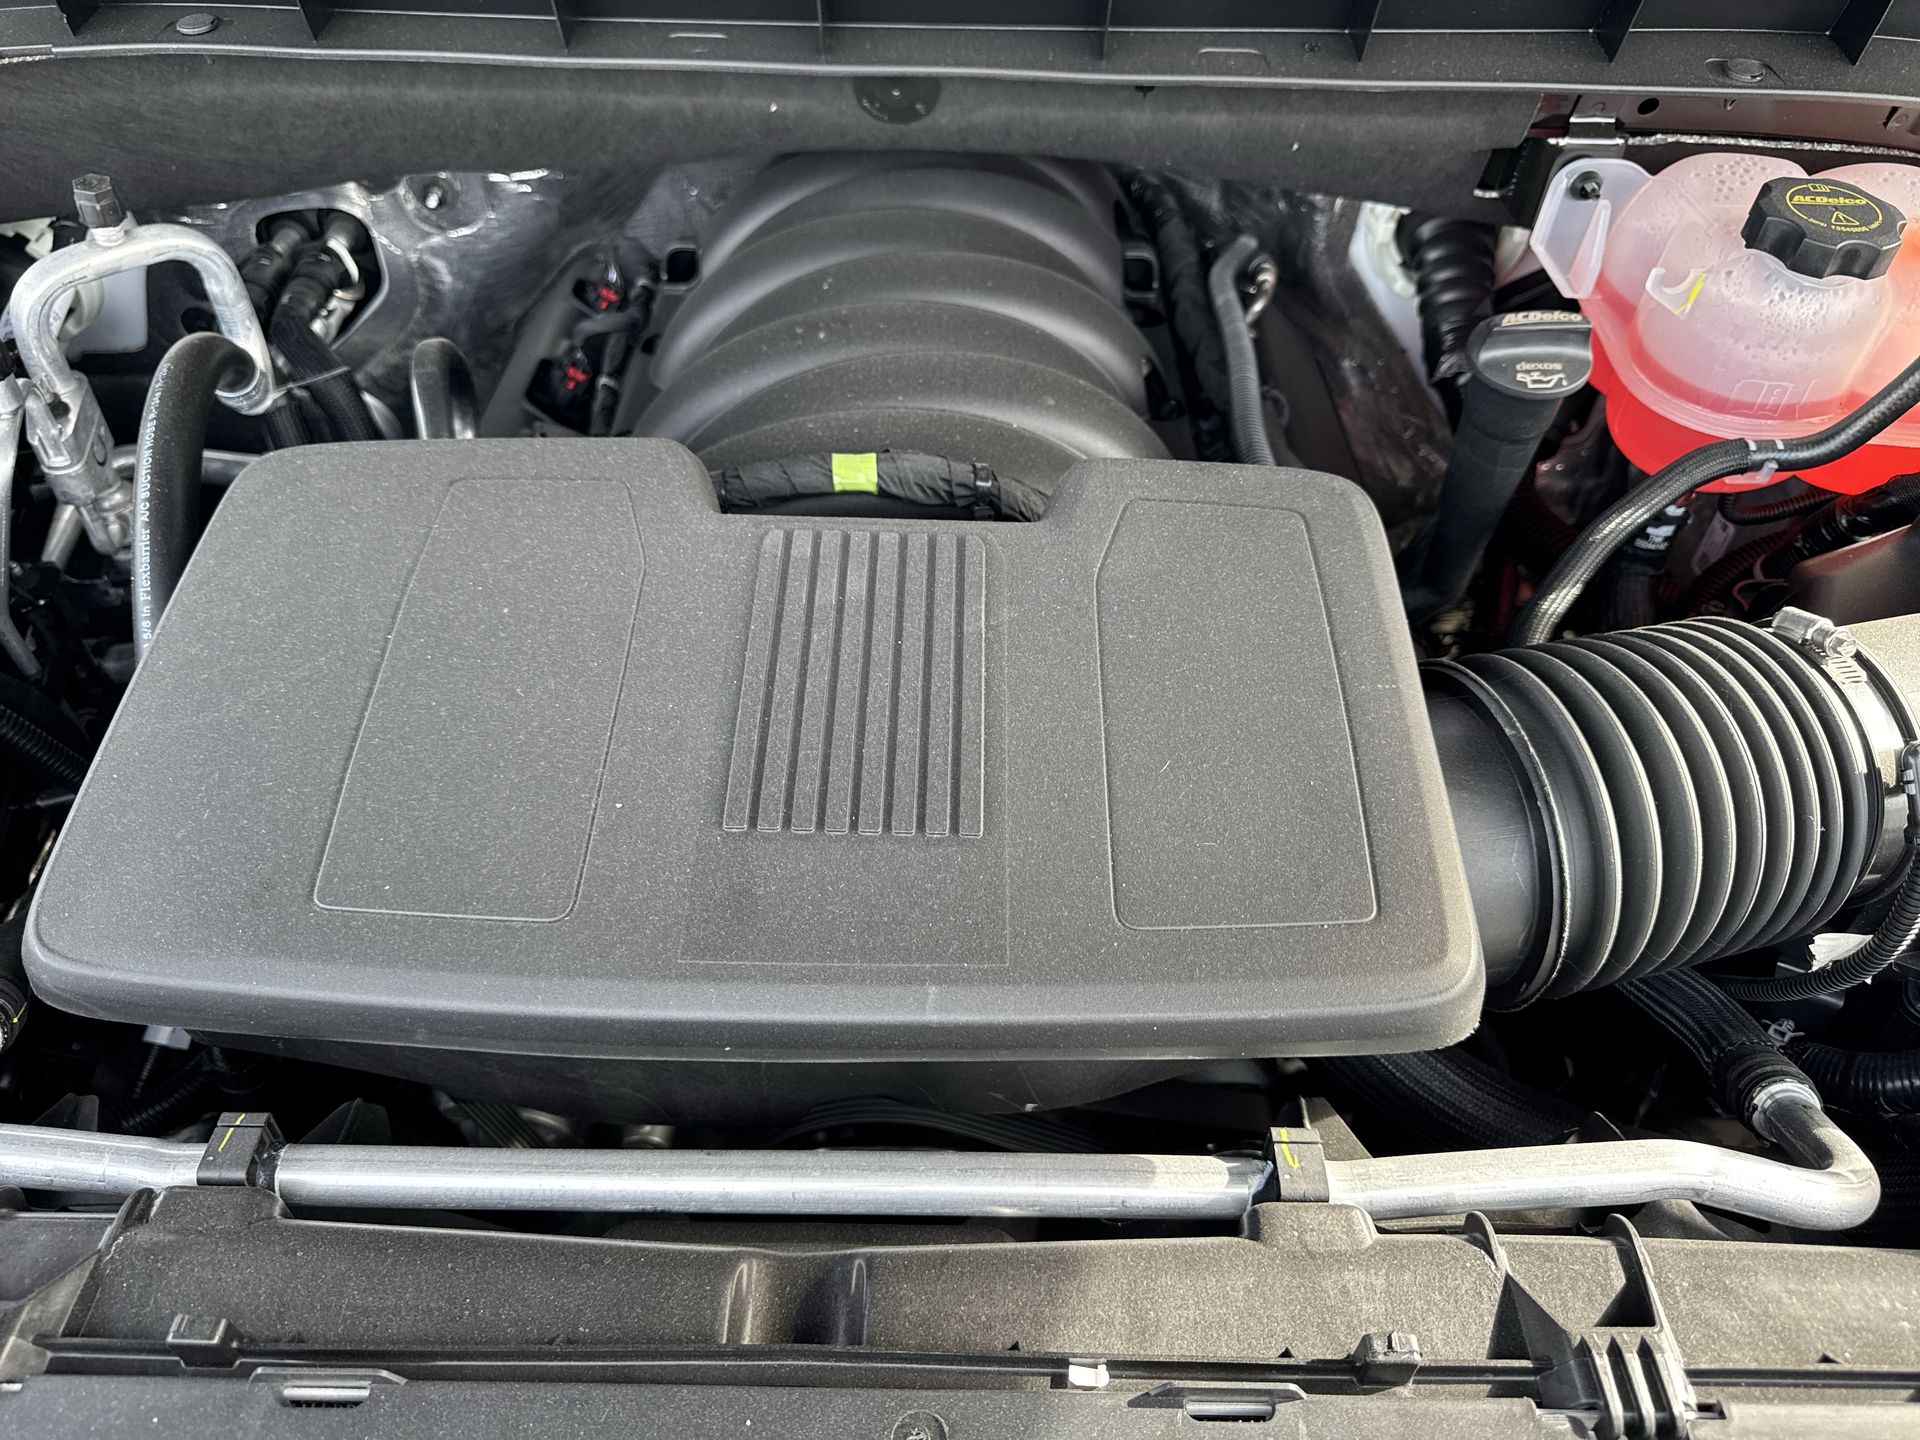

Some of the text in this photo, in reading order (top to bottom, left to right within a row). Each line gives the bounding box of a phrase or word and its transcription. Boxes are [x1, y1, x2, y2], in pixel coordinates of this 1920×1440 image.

[1792, 195, 1867, 204] ACDelco
[1501, 310, 1582, 325] ACDelco
[1515, 361, 1563, 371] dexos
[144, 419, 156, 449] HOSE
[140, 449, 153, 500] SUCTION
[140, 501, 150, 522] A/C
[140, 528, 151, 601] Flexbarrier
[142, 620, 152, 640] 5/8
